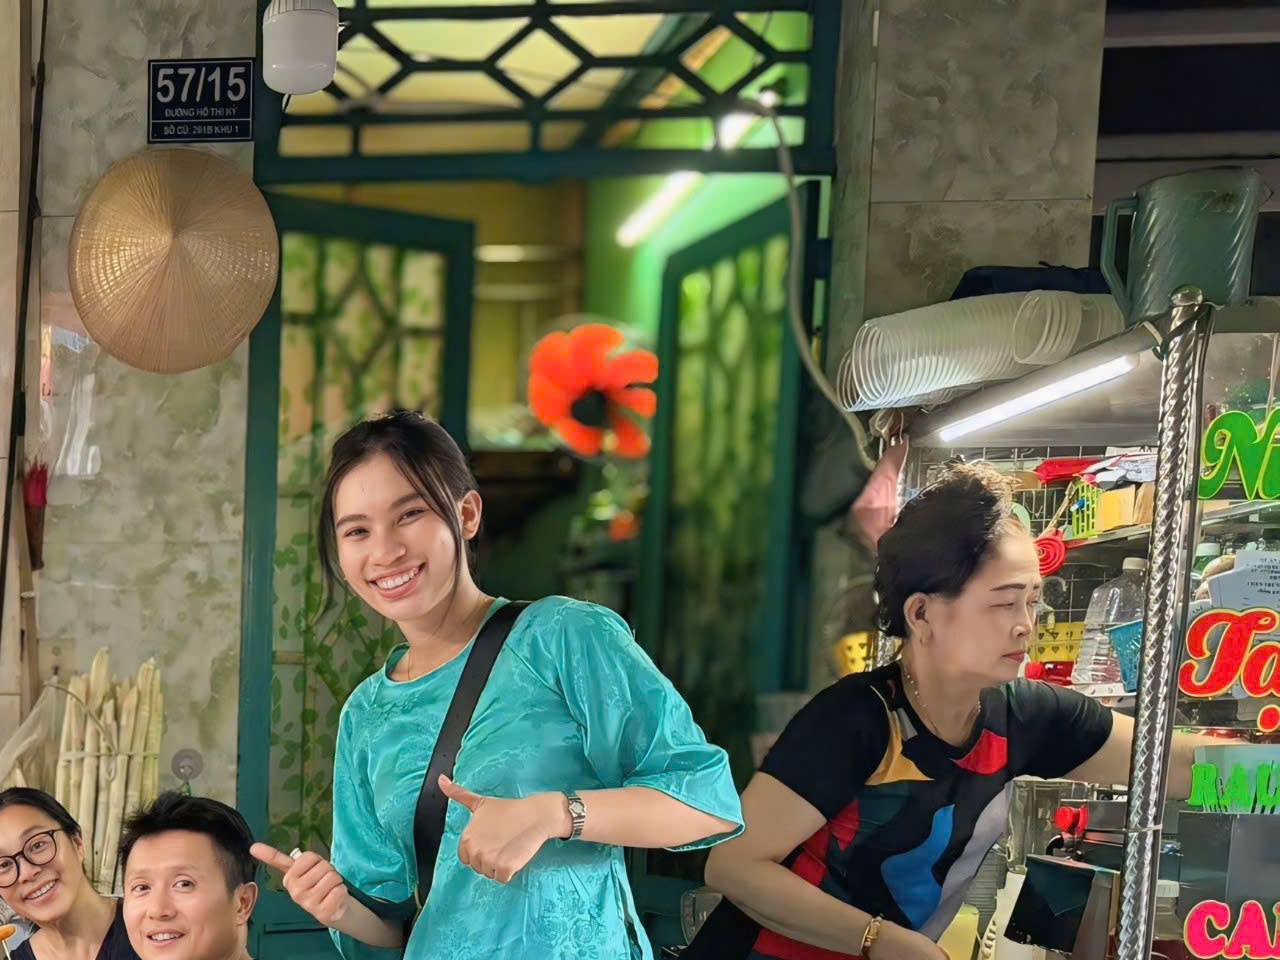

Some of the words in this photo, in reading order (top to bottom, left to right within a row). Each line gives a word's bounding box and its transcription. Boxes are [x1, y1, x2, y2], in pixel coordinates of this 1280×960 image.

[156, 66, 246, 103] 57/15
[214, 124, 233, 133] KHU
[1184, 900, 1280, 959] CA
